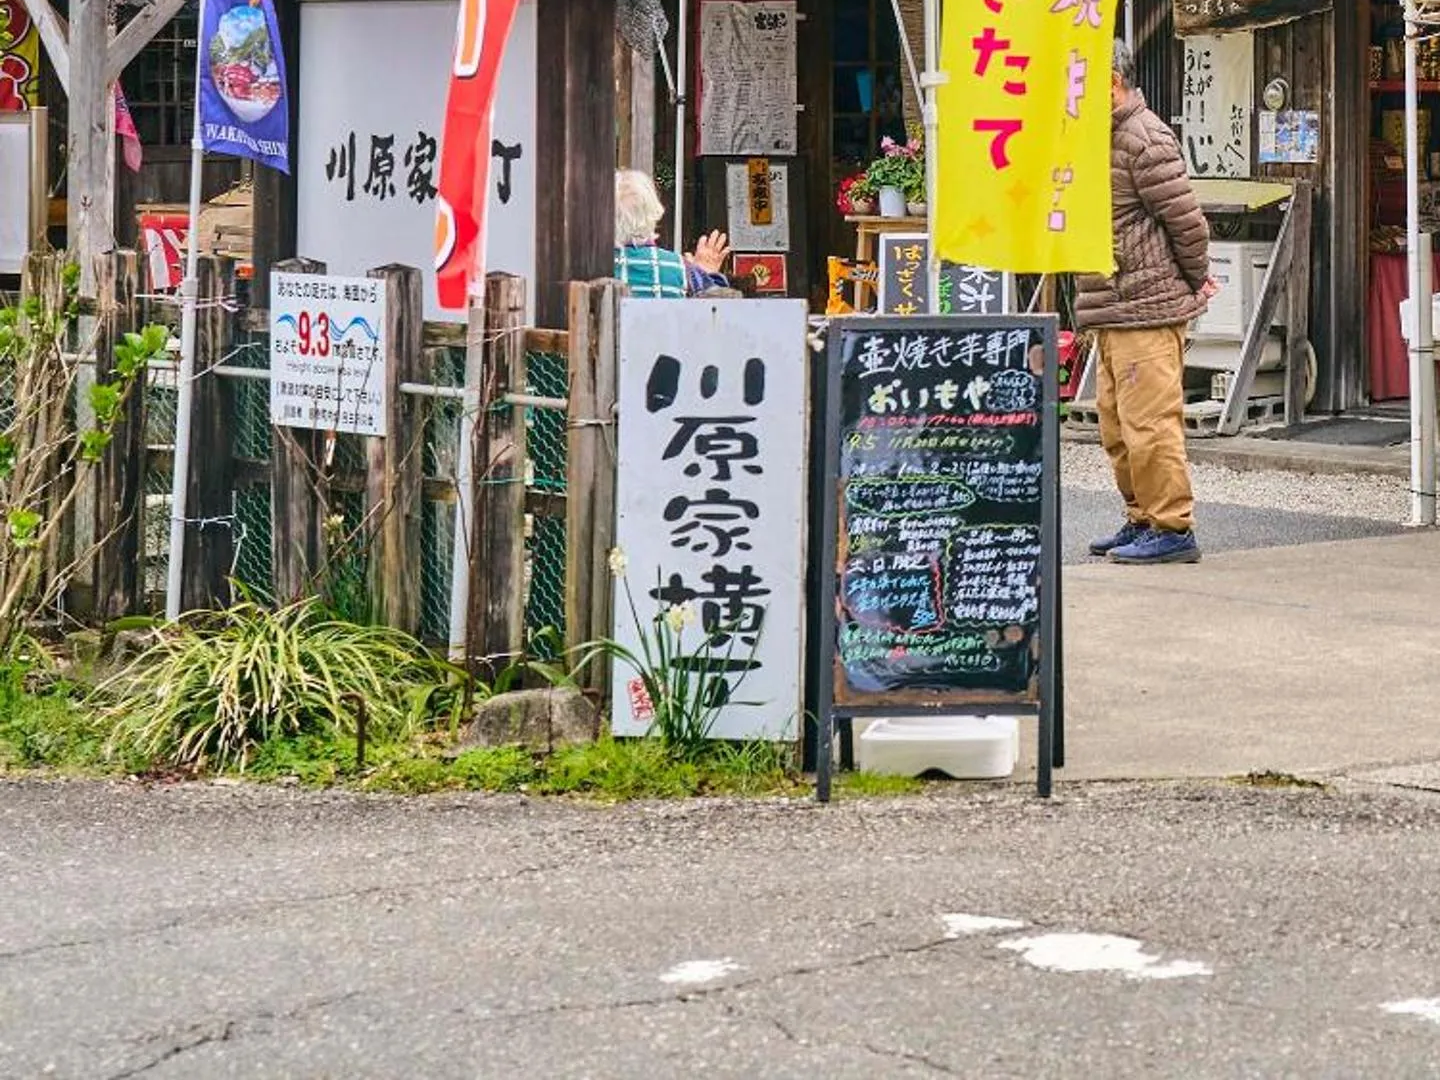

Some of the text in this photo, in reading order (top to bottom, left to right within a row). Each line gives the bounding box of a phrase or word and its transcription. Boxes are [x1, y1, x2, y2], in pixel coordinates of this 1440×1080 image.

[325, 131, 523, 205] 川原家丁
[298, 310, 330, 358] 9.3
[858, 328, 1031, 379] 壺焼き芋専門
[646, 353, 772, 709] 川原家横丁
